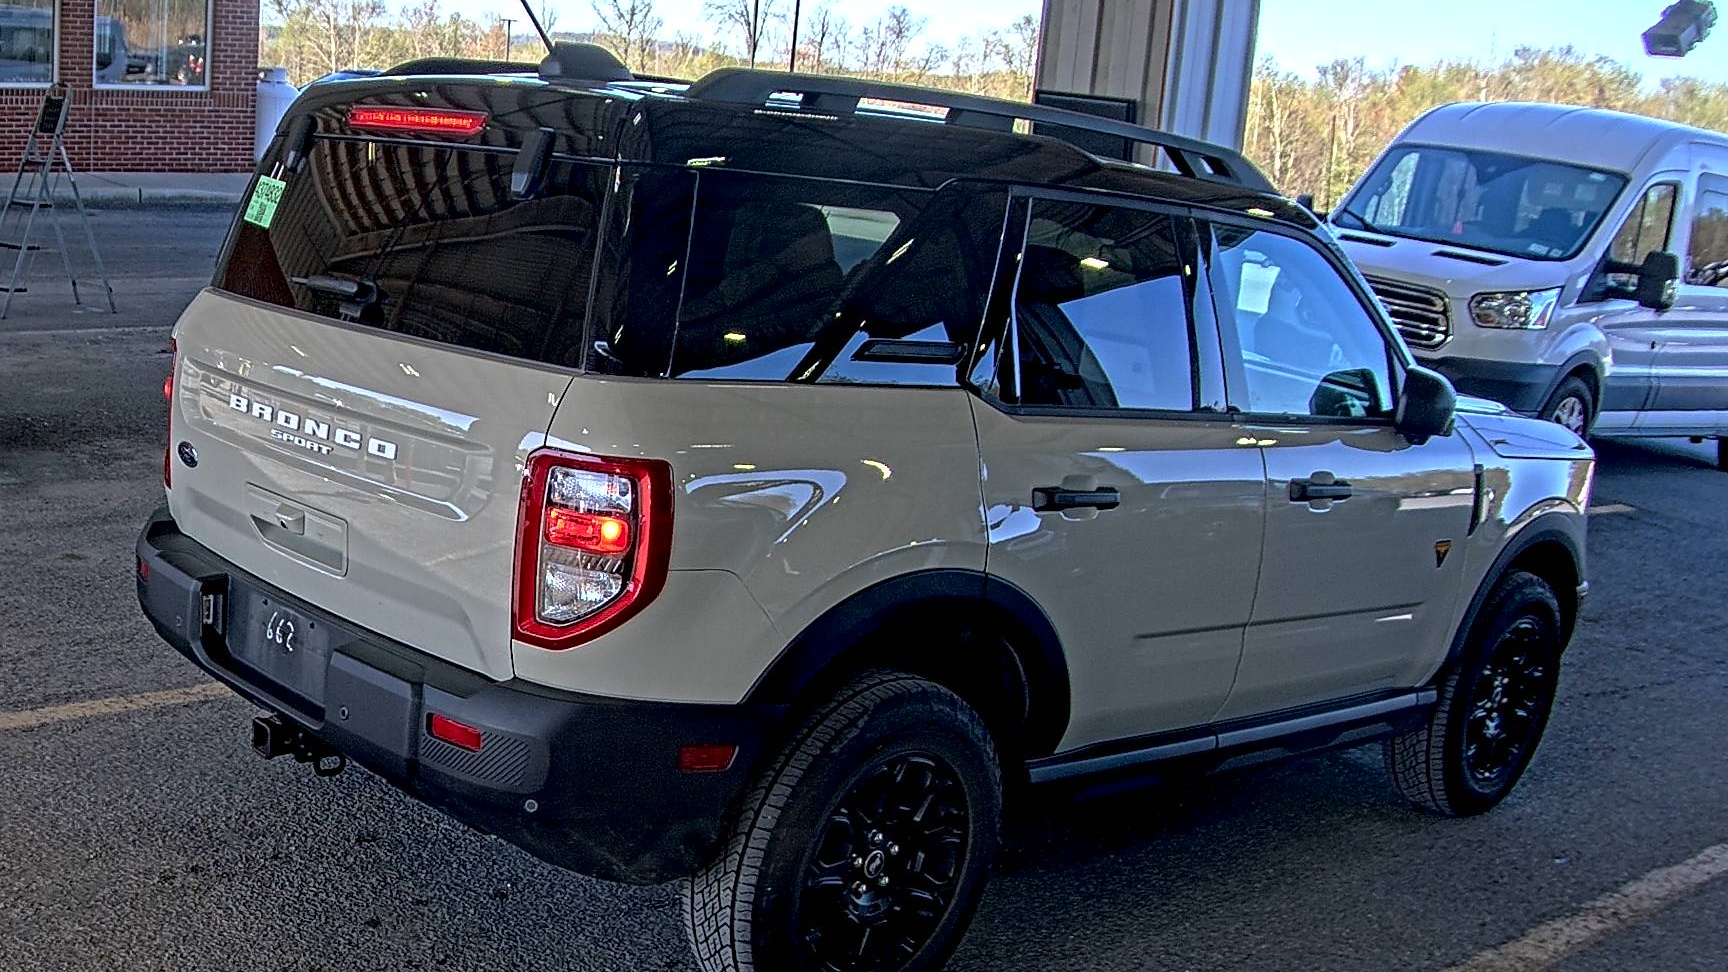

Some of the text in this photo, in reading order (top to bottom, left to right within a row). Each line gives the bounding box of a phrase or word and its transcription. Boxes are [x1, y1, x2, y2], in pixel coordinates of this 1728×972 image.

[228, 393, 398, 460] BRONCO
[270, 428, 333, 455] SPORT
[266, 611, 294, 652] 662
